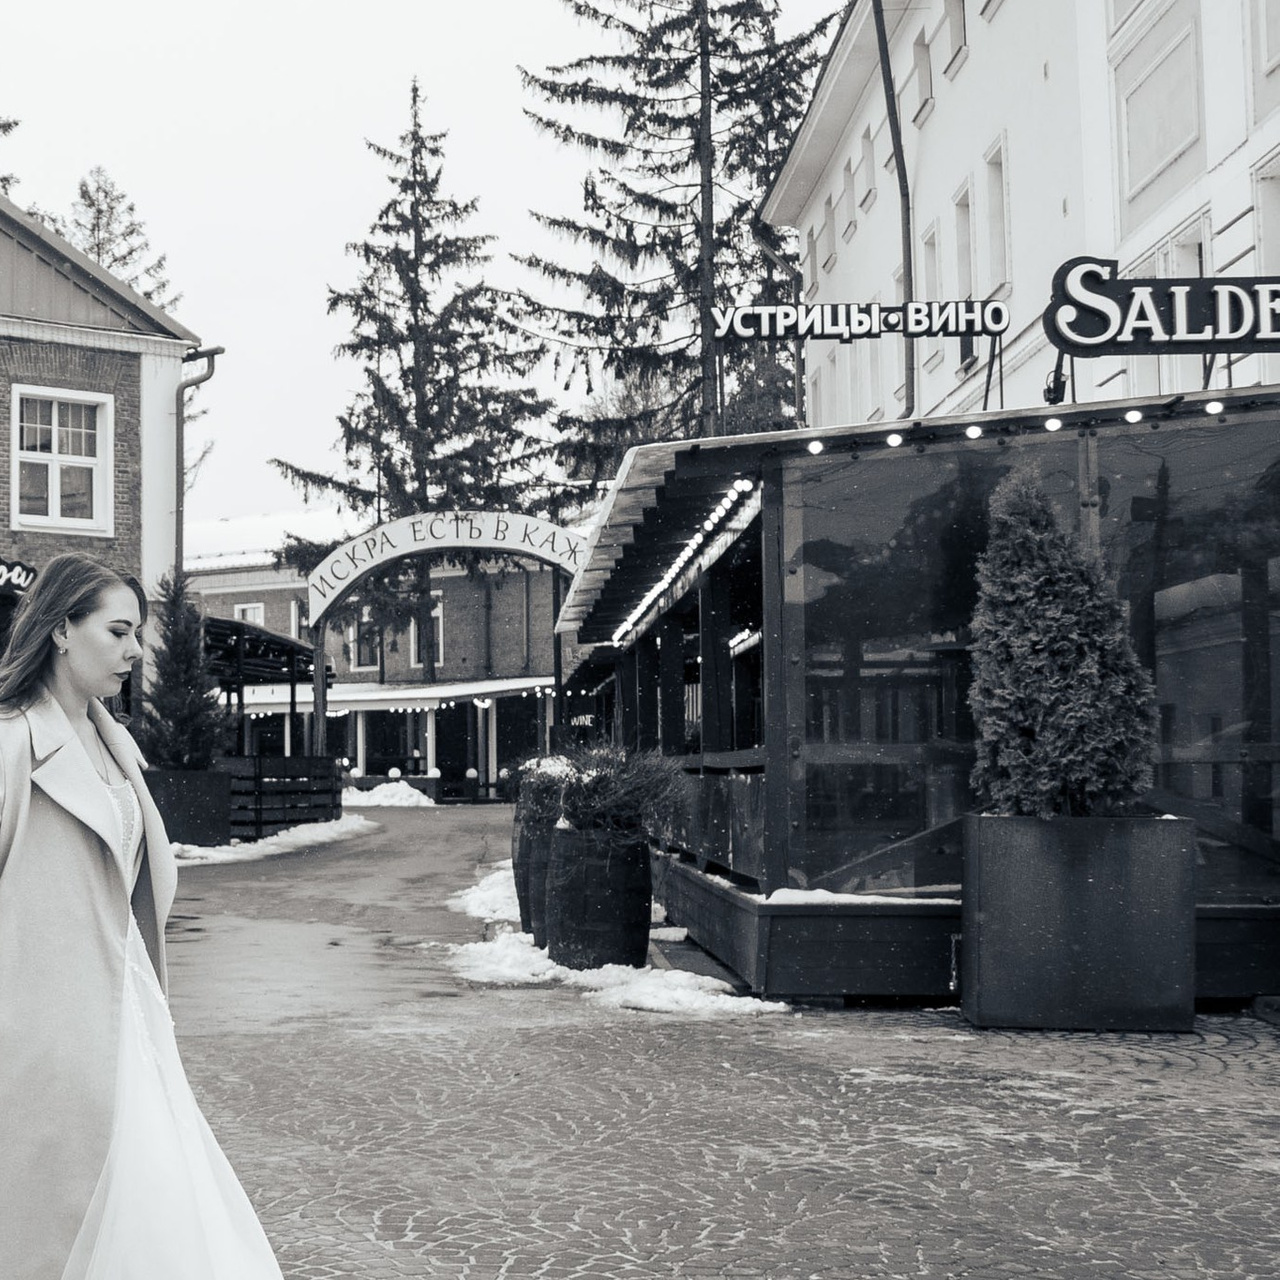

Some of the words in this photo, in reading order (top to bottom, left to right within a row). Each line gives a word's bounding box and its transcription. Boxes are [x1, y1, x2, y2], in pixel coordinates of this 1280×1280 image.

[711, 303, 881, 339] УСТРИЦЫ
[907, 301, 1010, 333] ВИНО
[1056, 263, 1280, 344] SALDE
[310, 530, 398, 599] ИСКРА
[411, 517, 482, 542] ЕСТЬ
[495, 516, 509, 541] В
[520, 522, 584, 571] КАЖ
[570, 714, 595, 727] WINE
